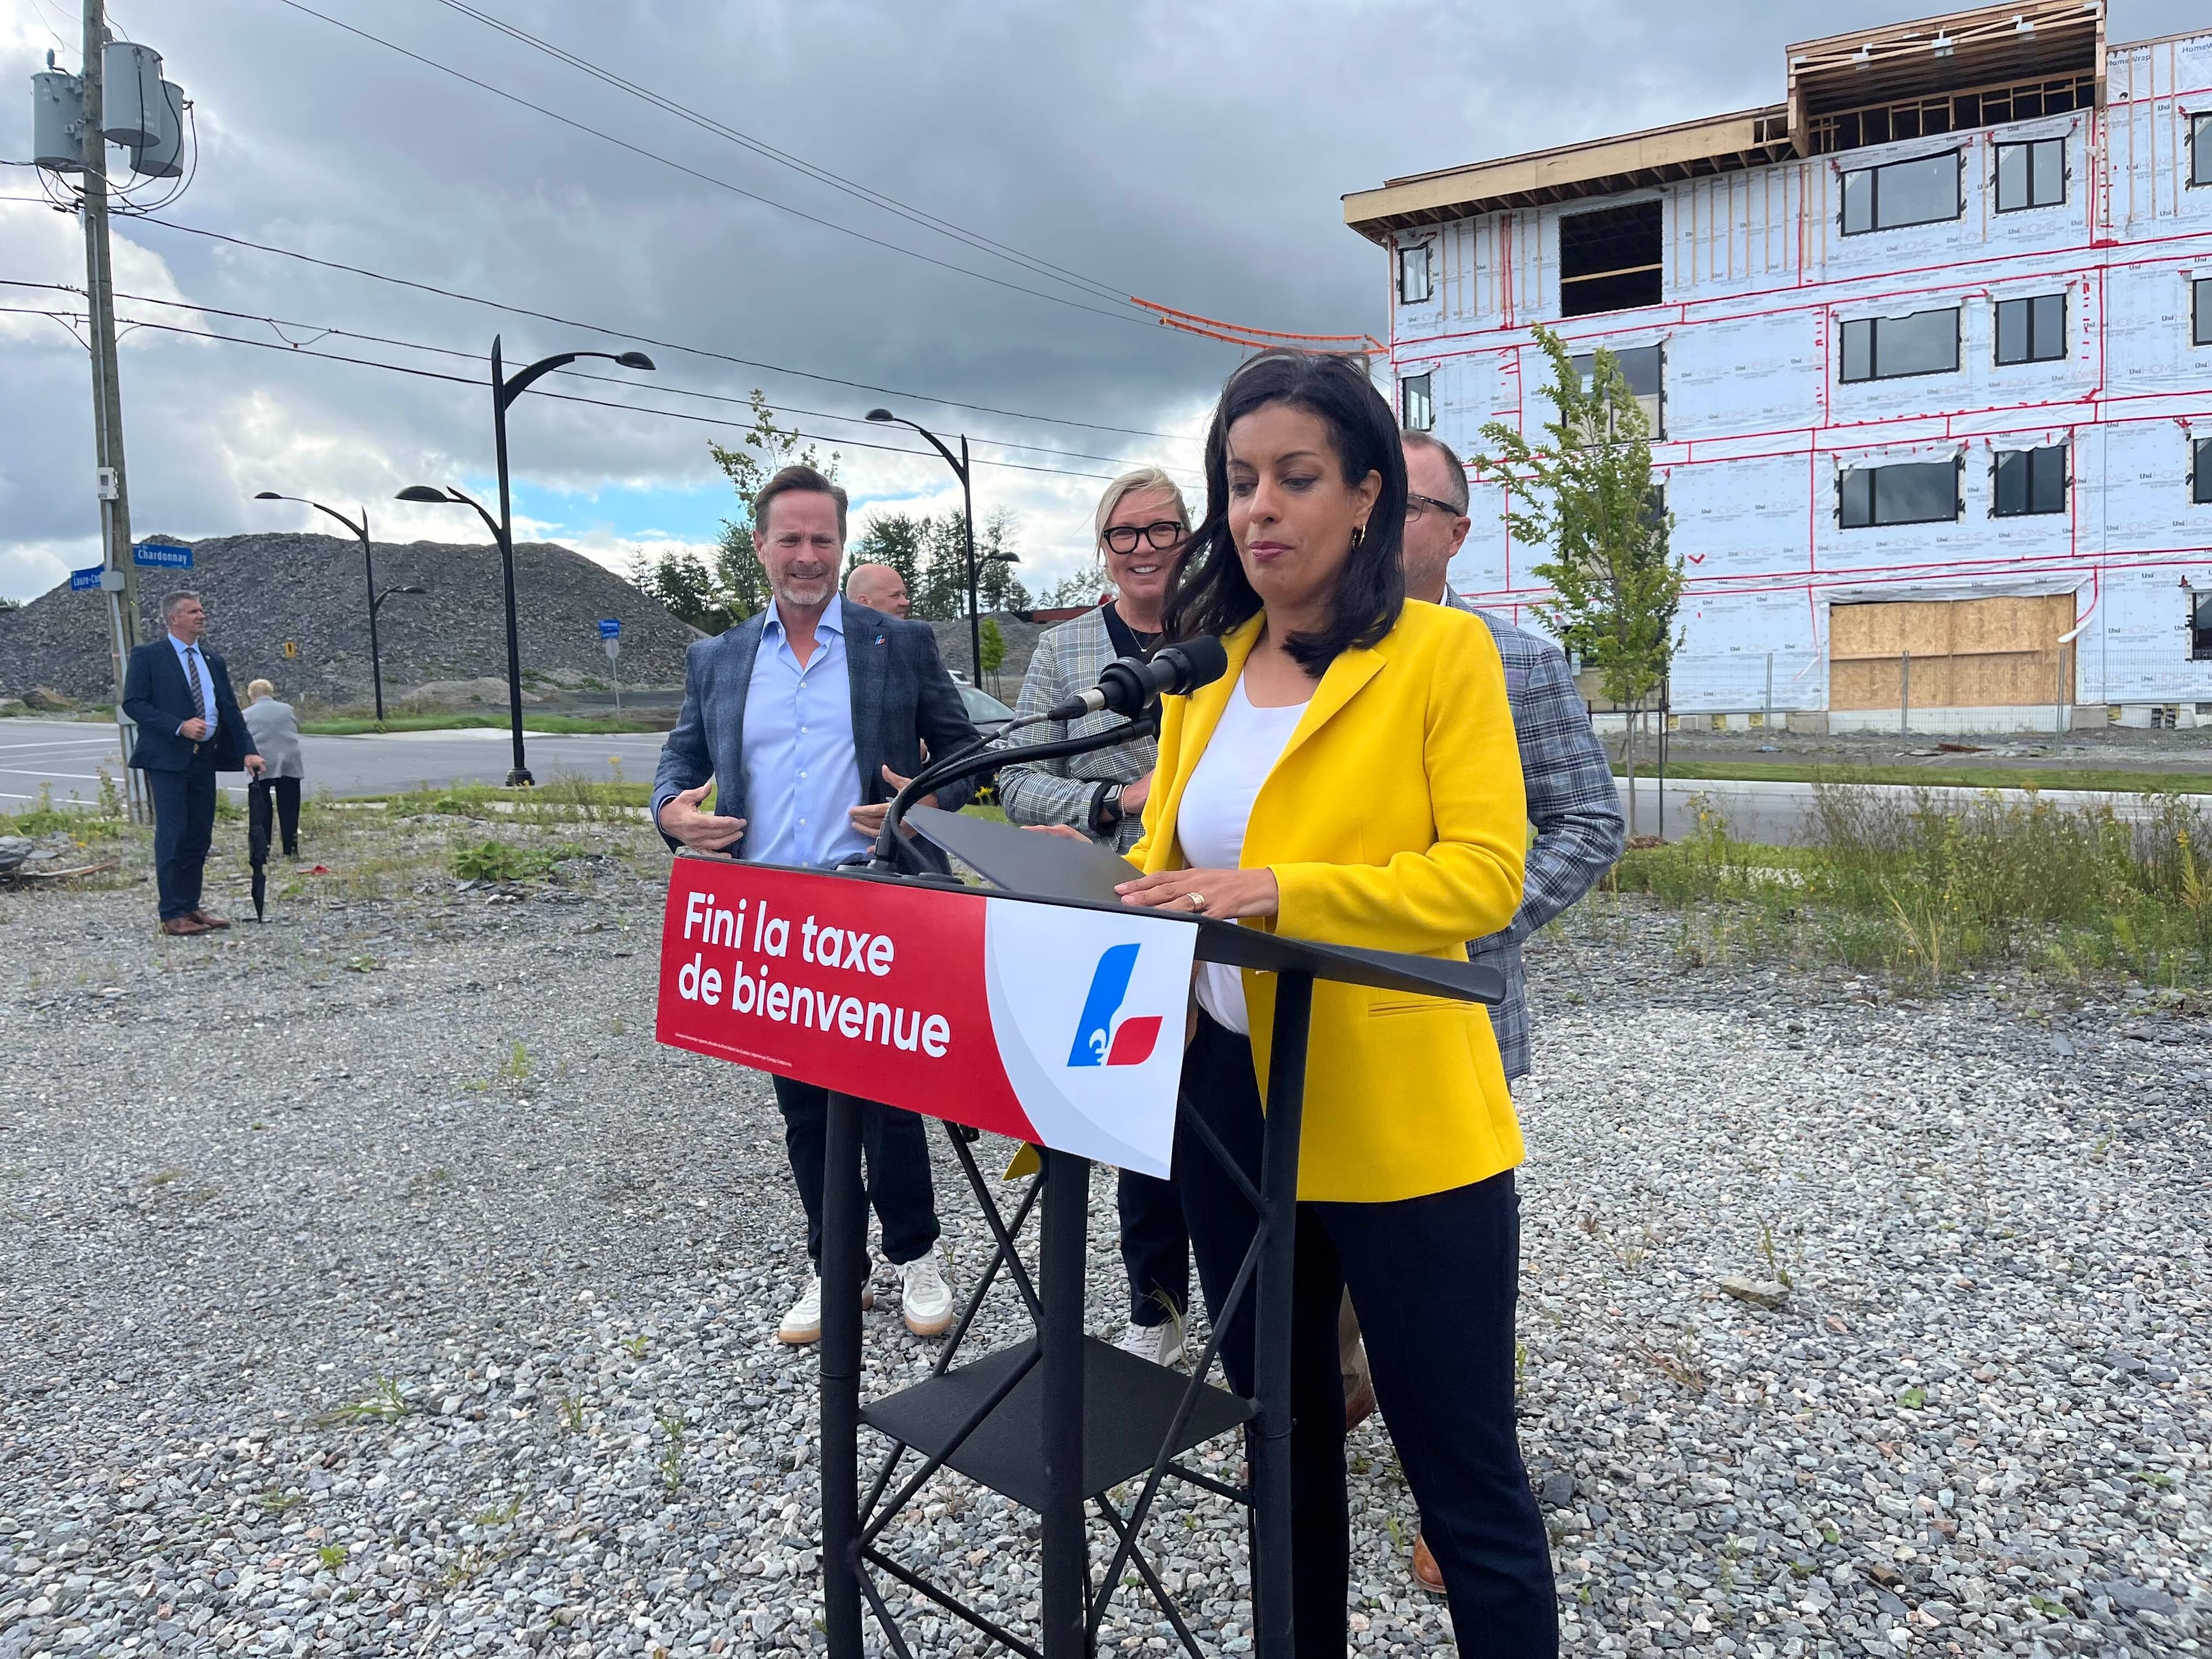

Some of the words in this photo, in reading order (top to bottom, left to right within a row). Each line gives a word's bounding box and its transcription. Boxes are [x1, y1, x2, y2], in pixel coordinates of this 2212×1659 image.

[138, 549, 187, 565] Chardonnay
[684, 891, 747, 949] Fini
[753, 900, 790, 957] la
[801, 915, 895, 976] taxe
[679, 952, 722, 1006] de
[732, 960, 950, 1058] bienvenue
